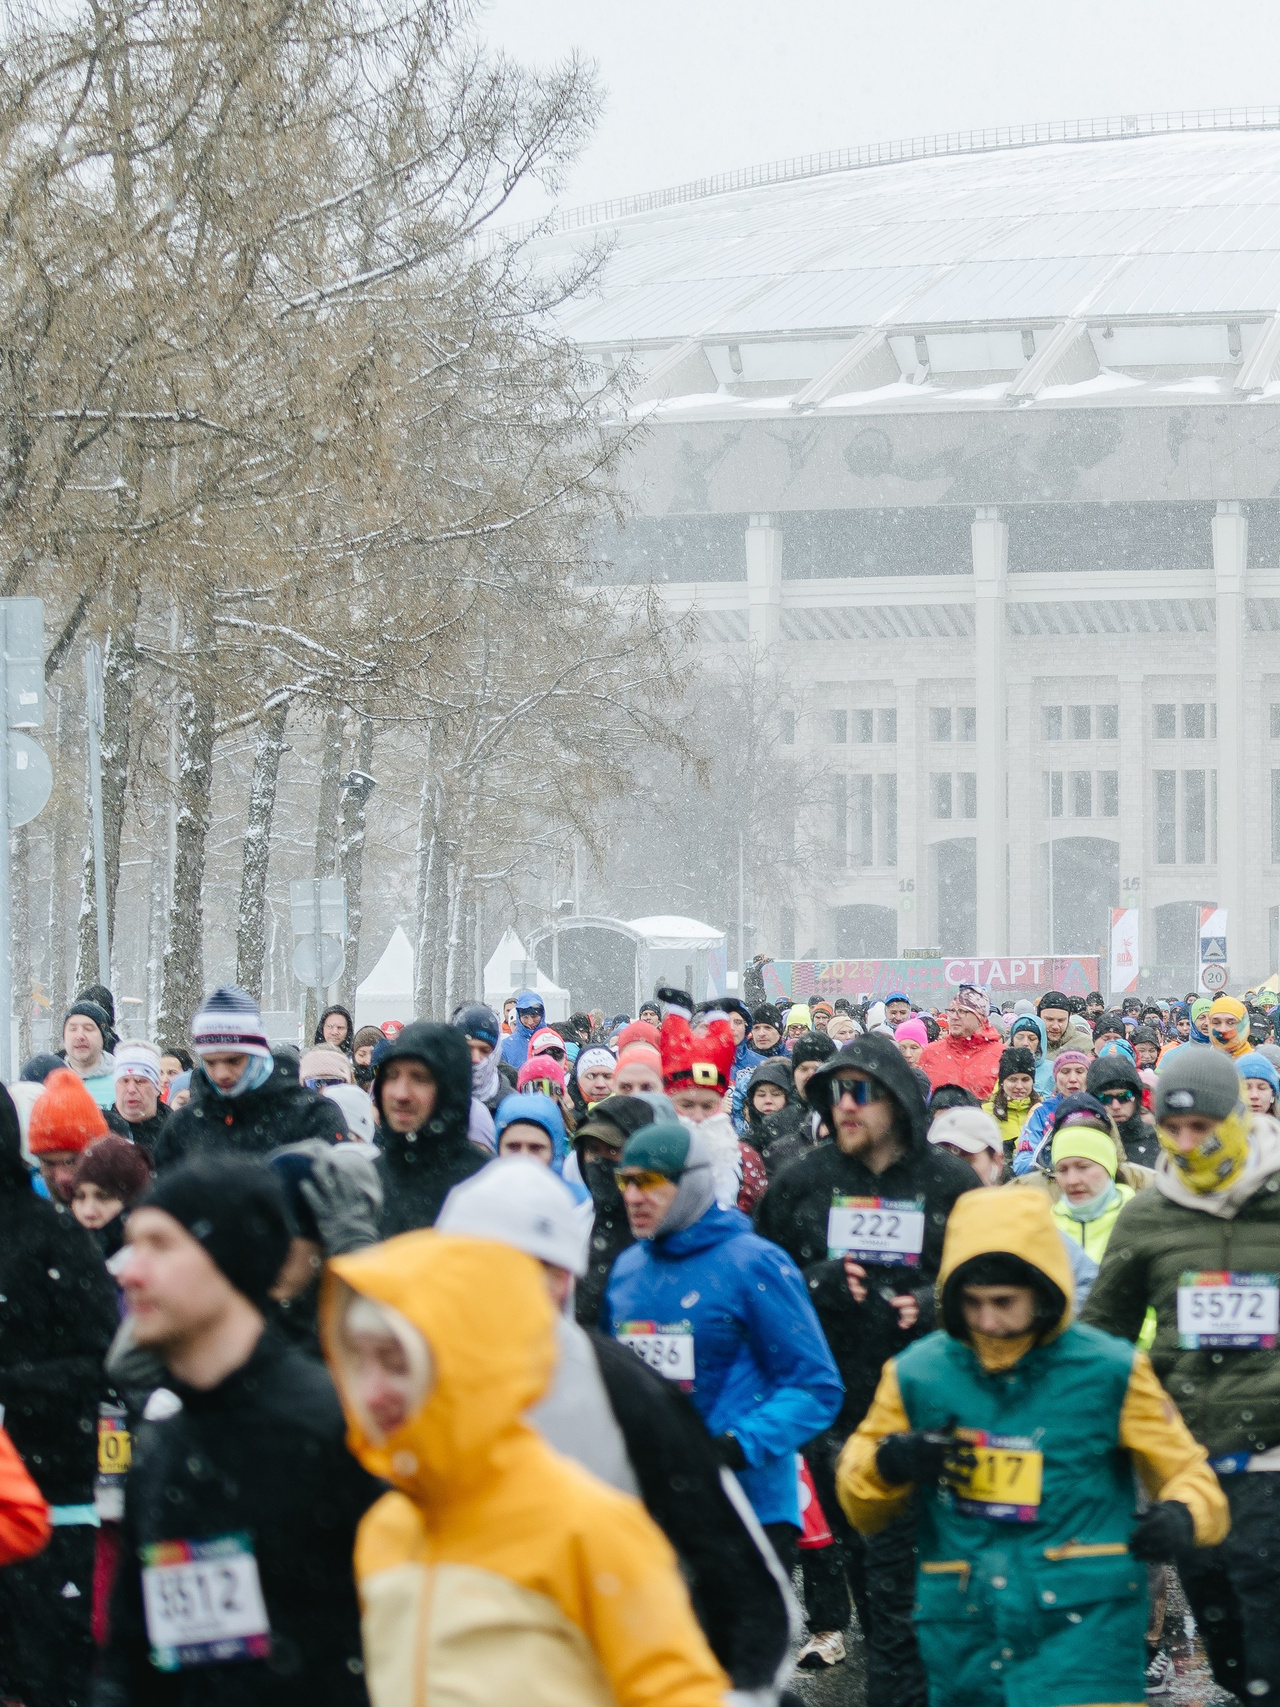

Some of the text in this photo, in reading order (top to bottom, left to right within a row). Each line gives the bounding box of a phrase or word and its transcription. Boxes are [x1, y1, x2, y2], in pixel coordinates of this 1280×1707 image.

[899, 879, 914, 892] 16
[818, 962, 874, 978] 2025
[944, 960, 1044, 985] СТАРТ
[1207, 973, 1222, 983] 20
[850, 1214, 900, 1238] 222
[1191, 1293, 1264, 1318] 5572
